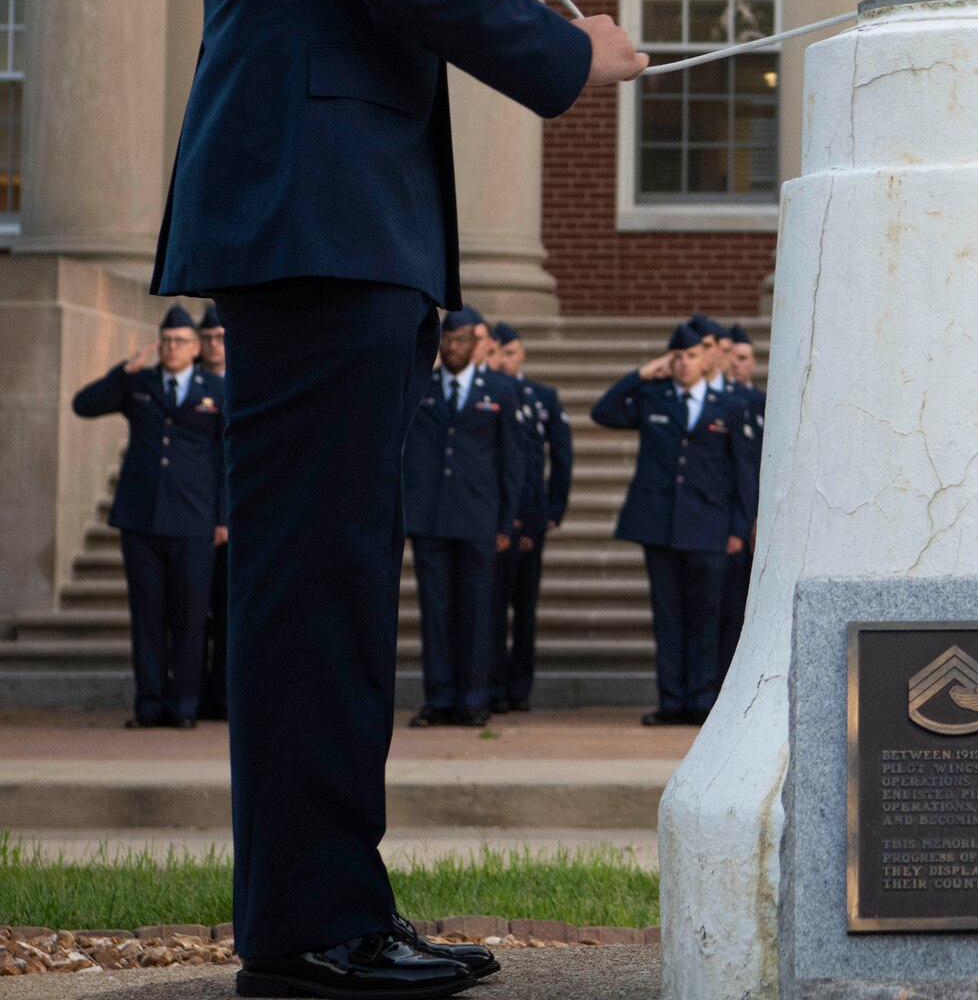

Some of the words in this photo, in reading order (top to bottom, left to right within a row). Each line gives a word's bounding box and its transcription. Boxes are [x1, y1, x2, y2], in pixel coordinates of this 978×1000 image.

[882, 750, 951, 760] BETWEEN
[882, 763, 926, 773] PILOT
[882, 776, 970, 786] OPERATIONS
[882, 790, 953, 800] ENLISTED
[882, 816, 913, 825] AND
[882, 839, 915, 849] THIS
[883, 852, 954, 862] PROGRESS
[960, 852, 976, 862] OF
[882, 866, 921, 876] THEY
[883, 879, 928, 889] THEIR
